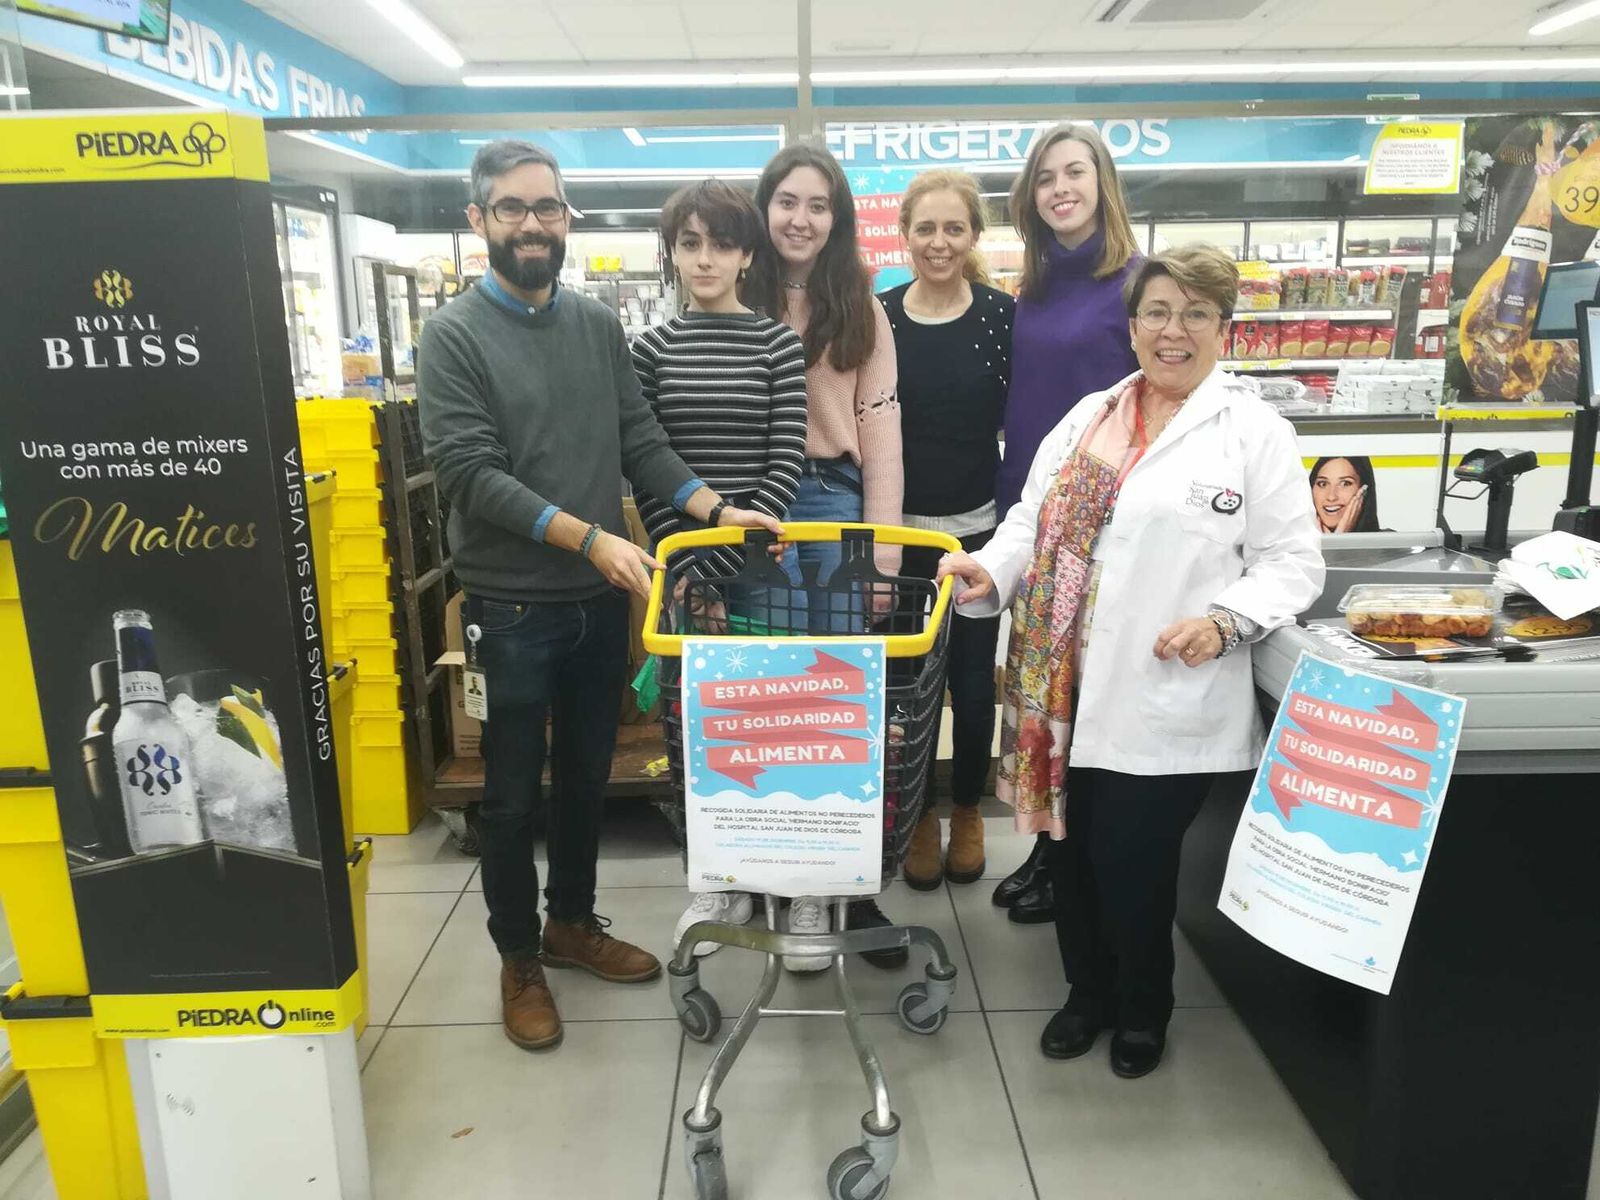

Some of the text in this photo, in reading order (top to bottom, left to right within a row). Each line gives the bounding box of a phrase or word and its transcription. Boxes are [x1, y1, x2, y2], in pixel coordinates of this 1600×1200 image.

[825, 118, 1172, 160] EFRIGERAOS
[854, 198, 878, 211] STA
[75, 314, 161, 333] ROYAL
[42, 333, 200, 370] BLISS
[20, 435, 249, 462] Una gama de mixers
[60, 457, 222, 480] con más de 40
[33, 496, 259, 561] Matices
[283, 447, 331, 760] GRACIAS POR SU VISITA
[714, 678, 849, 699] ESTA NAVIDAD,
[713, 711, 856, 732] TU SOLIDARIDAD
[1294, 698, 1420, 744] ESTA NAVIDAD,
[729, 745, 846, 764] ALIMENTA
[1284, 733, 1417, 782] TU SOLIDARIDAD
[1279, 770, 1394, 820] ALIMENTA
